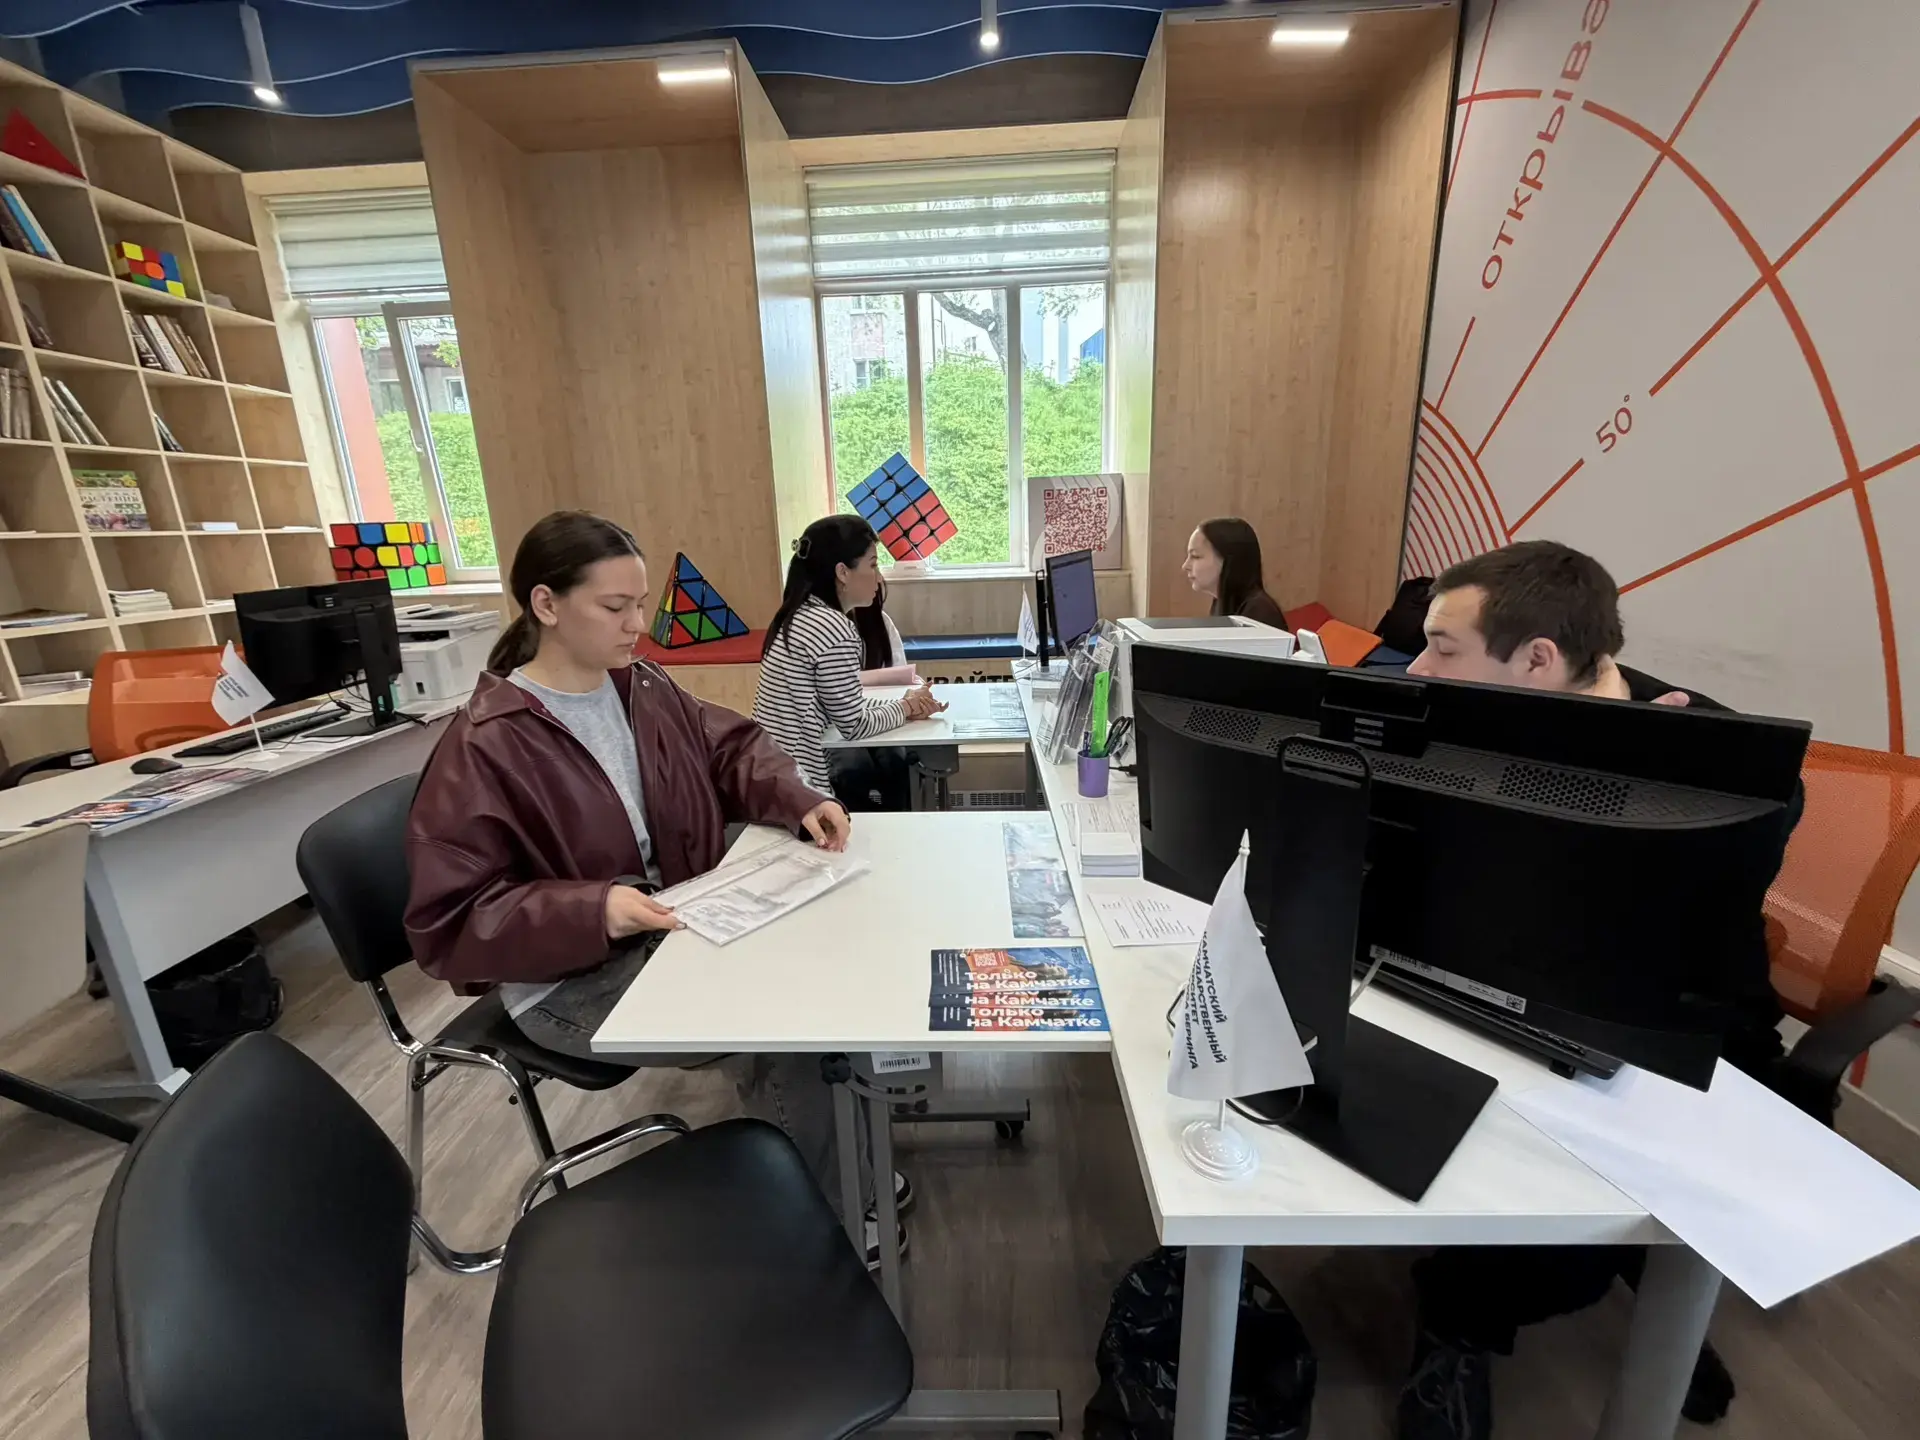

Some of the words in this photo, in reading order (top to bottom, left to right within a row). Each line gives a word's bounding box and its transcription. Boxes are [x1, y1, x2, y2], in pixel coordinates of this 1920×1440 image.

[965, 971, 1038, 982] Только
[1202, 930, 1228, 1024] КАМЧАТСКИЙ
[966, 981, 991, 991] на
[995, 977, 1091, 991] Камчатке
[964, 995, 990, 1006] на
[995, 994, 1095, 1007] Камчатке
[966, 1018, 994, 1028] на
[997, 1015, 1102, 1028] Камчатке
[1184, 1012, 1199, 1070] БЕРИНГА
